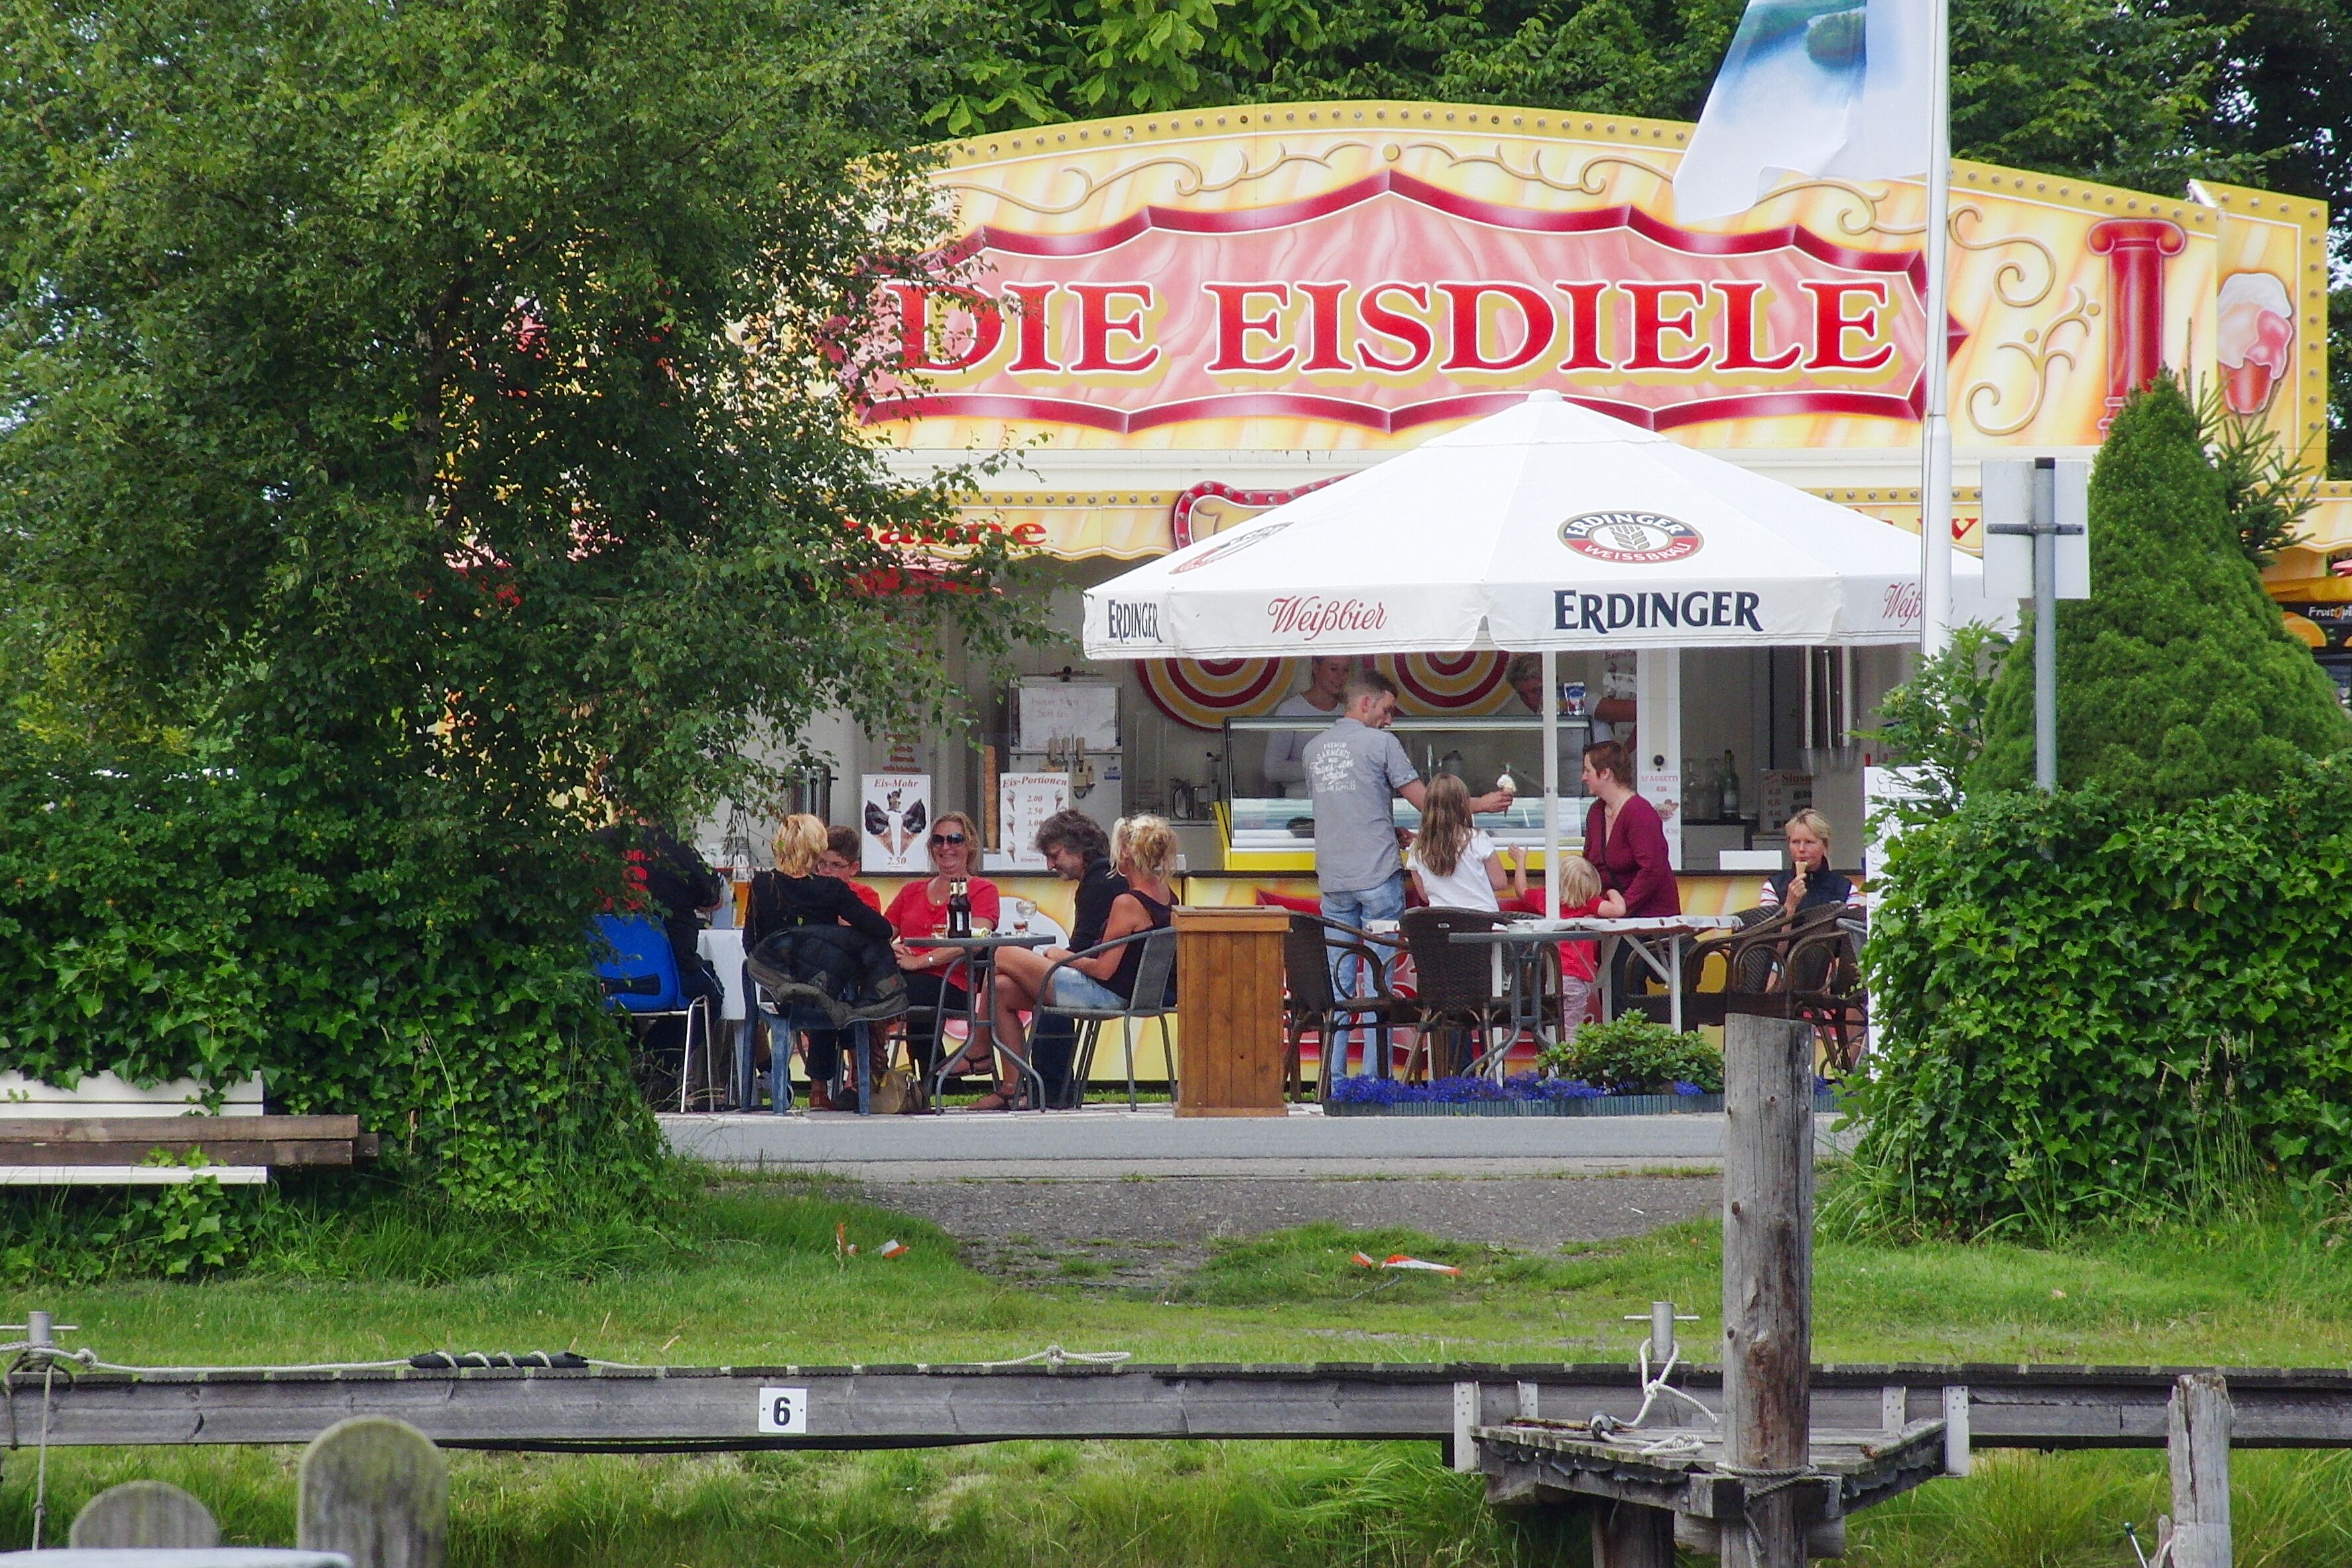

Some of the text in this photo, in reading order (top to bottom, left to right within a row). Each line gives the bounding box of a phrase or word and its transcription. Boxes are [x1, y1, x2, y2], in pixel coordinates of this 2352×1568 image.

[885, 279, 1894, 375] DIE EISDIELE
[1566, 513, 1686, 536] ERDINGER
[1108, 599, 1163, 644] ERDINGER
[1267, 595, 1388, 641] Weißbier
[1553, 589, 1764, 634] ERDINGER
[874, 778, 918, 788] Eis-Mohr
[1002, 775, 1068, 788] Eis-Portionen
[887, 856, 906, 866] 2.50
[773, 1396, 791, 1427] 6
